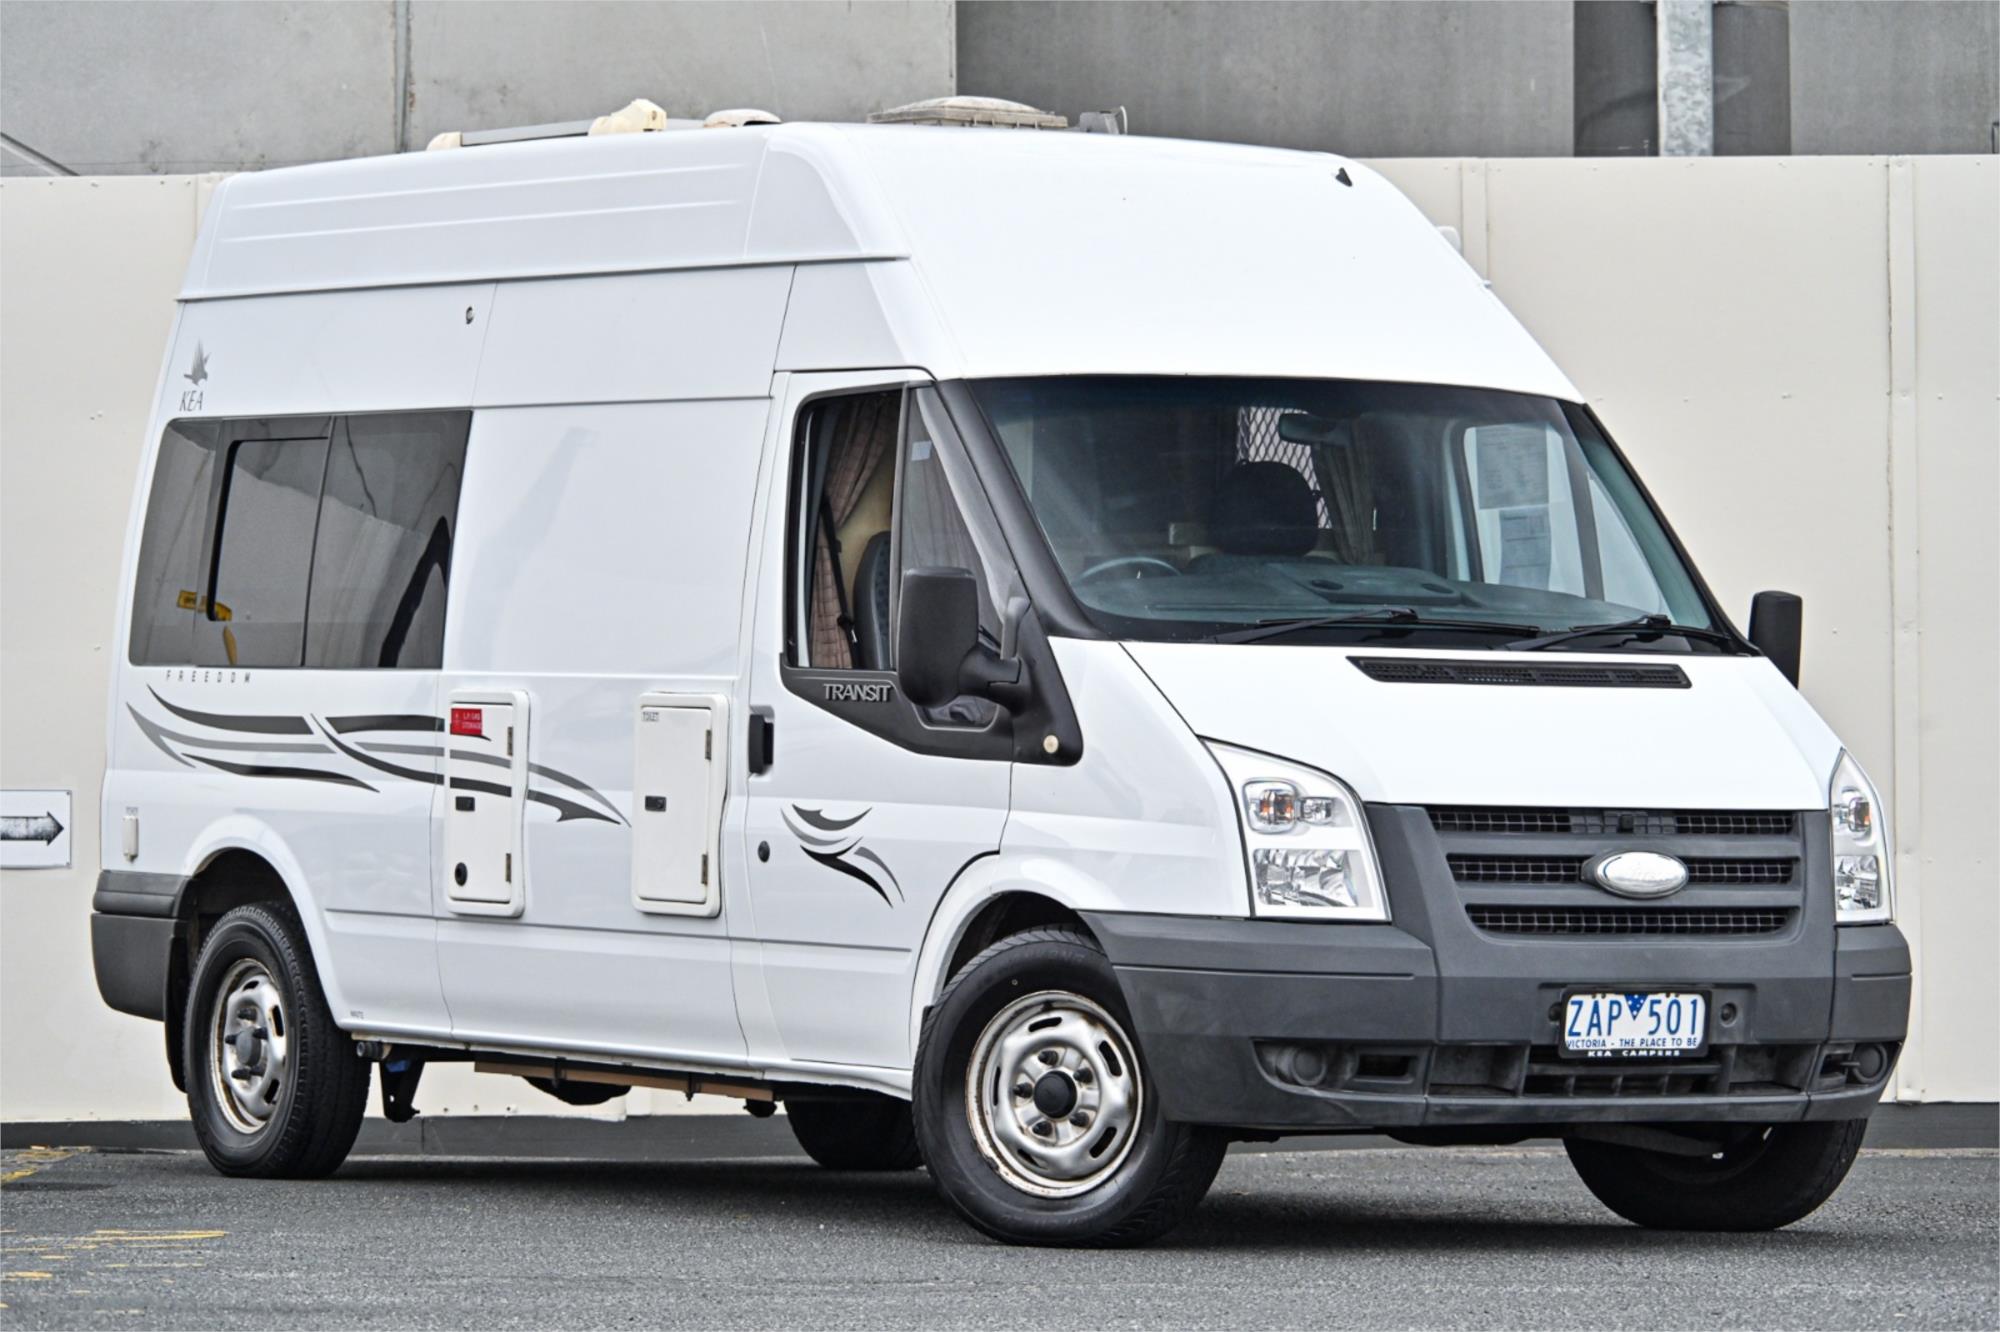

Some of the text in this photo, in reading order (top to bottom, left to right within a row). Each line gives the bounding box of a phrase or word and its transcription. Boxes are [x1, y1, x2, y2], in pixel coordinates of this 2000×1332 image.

[179, 390, 204, 411] KEA
[166, 669, 251, 683] FREEDOM
[823, 683, 891, 702] TRANSIT
[1567, 998, 1698, 1037] ZAP 501
[1567, 1038, 1607, 1049] VICTORIA
[1619, 1038, 1636, 1048] THE
[1640, 1038, 1667, 1047] PLACE
[1671, 1037, 1683, 1047] TO
[1687, 1037, 1697, 1047] BE
